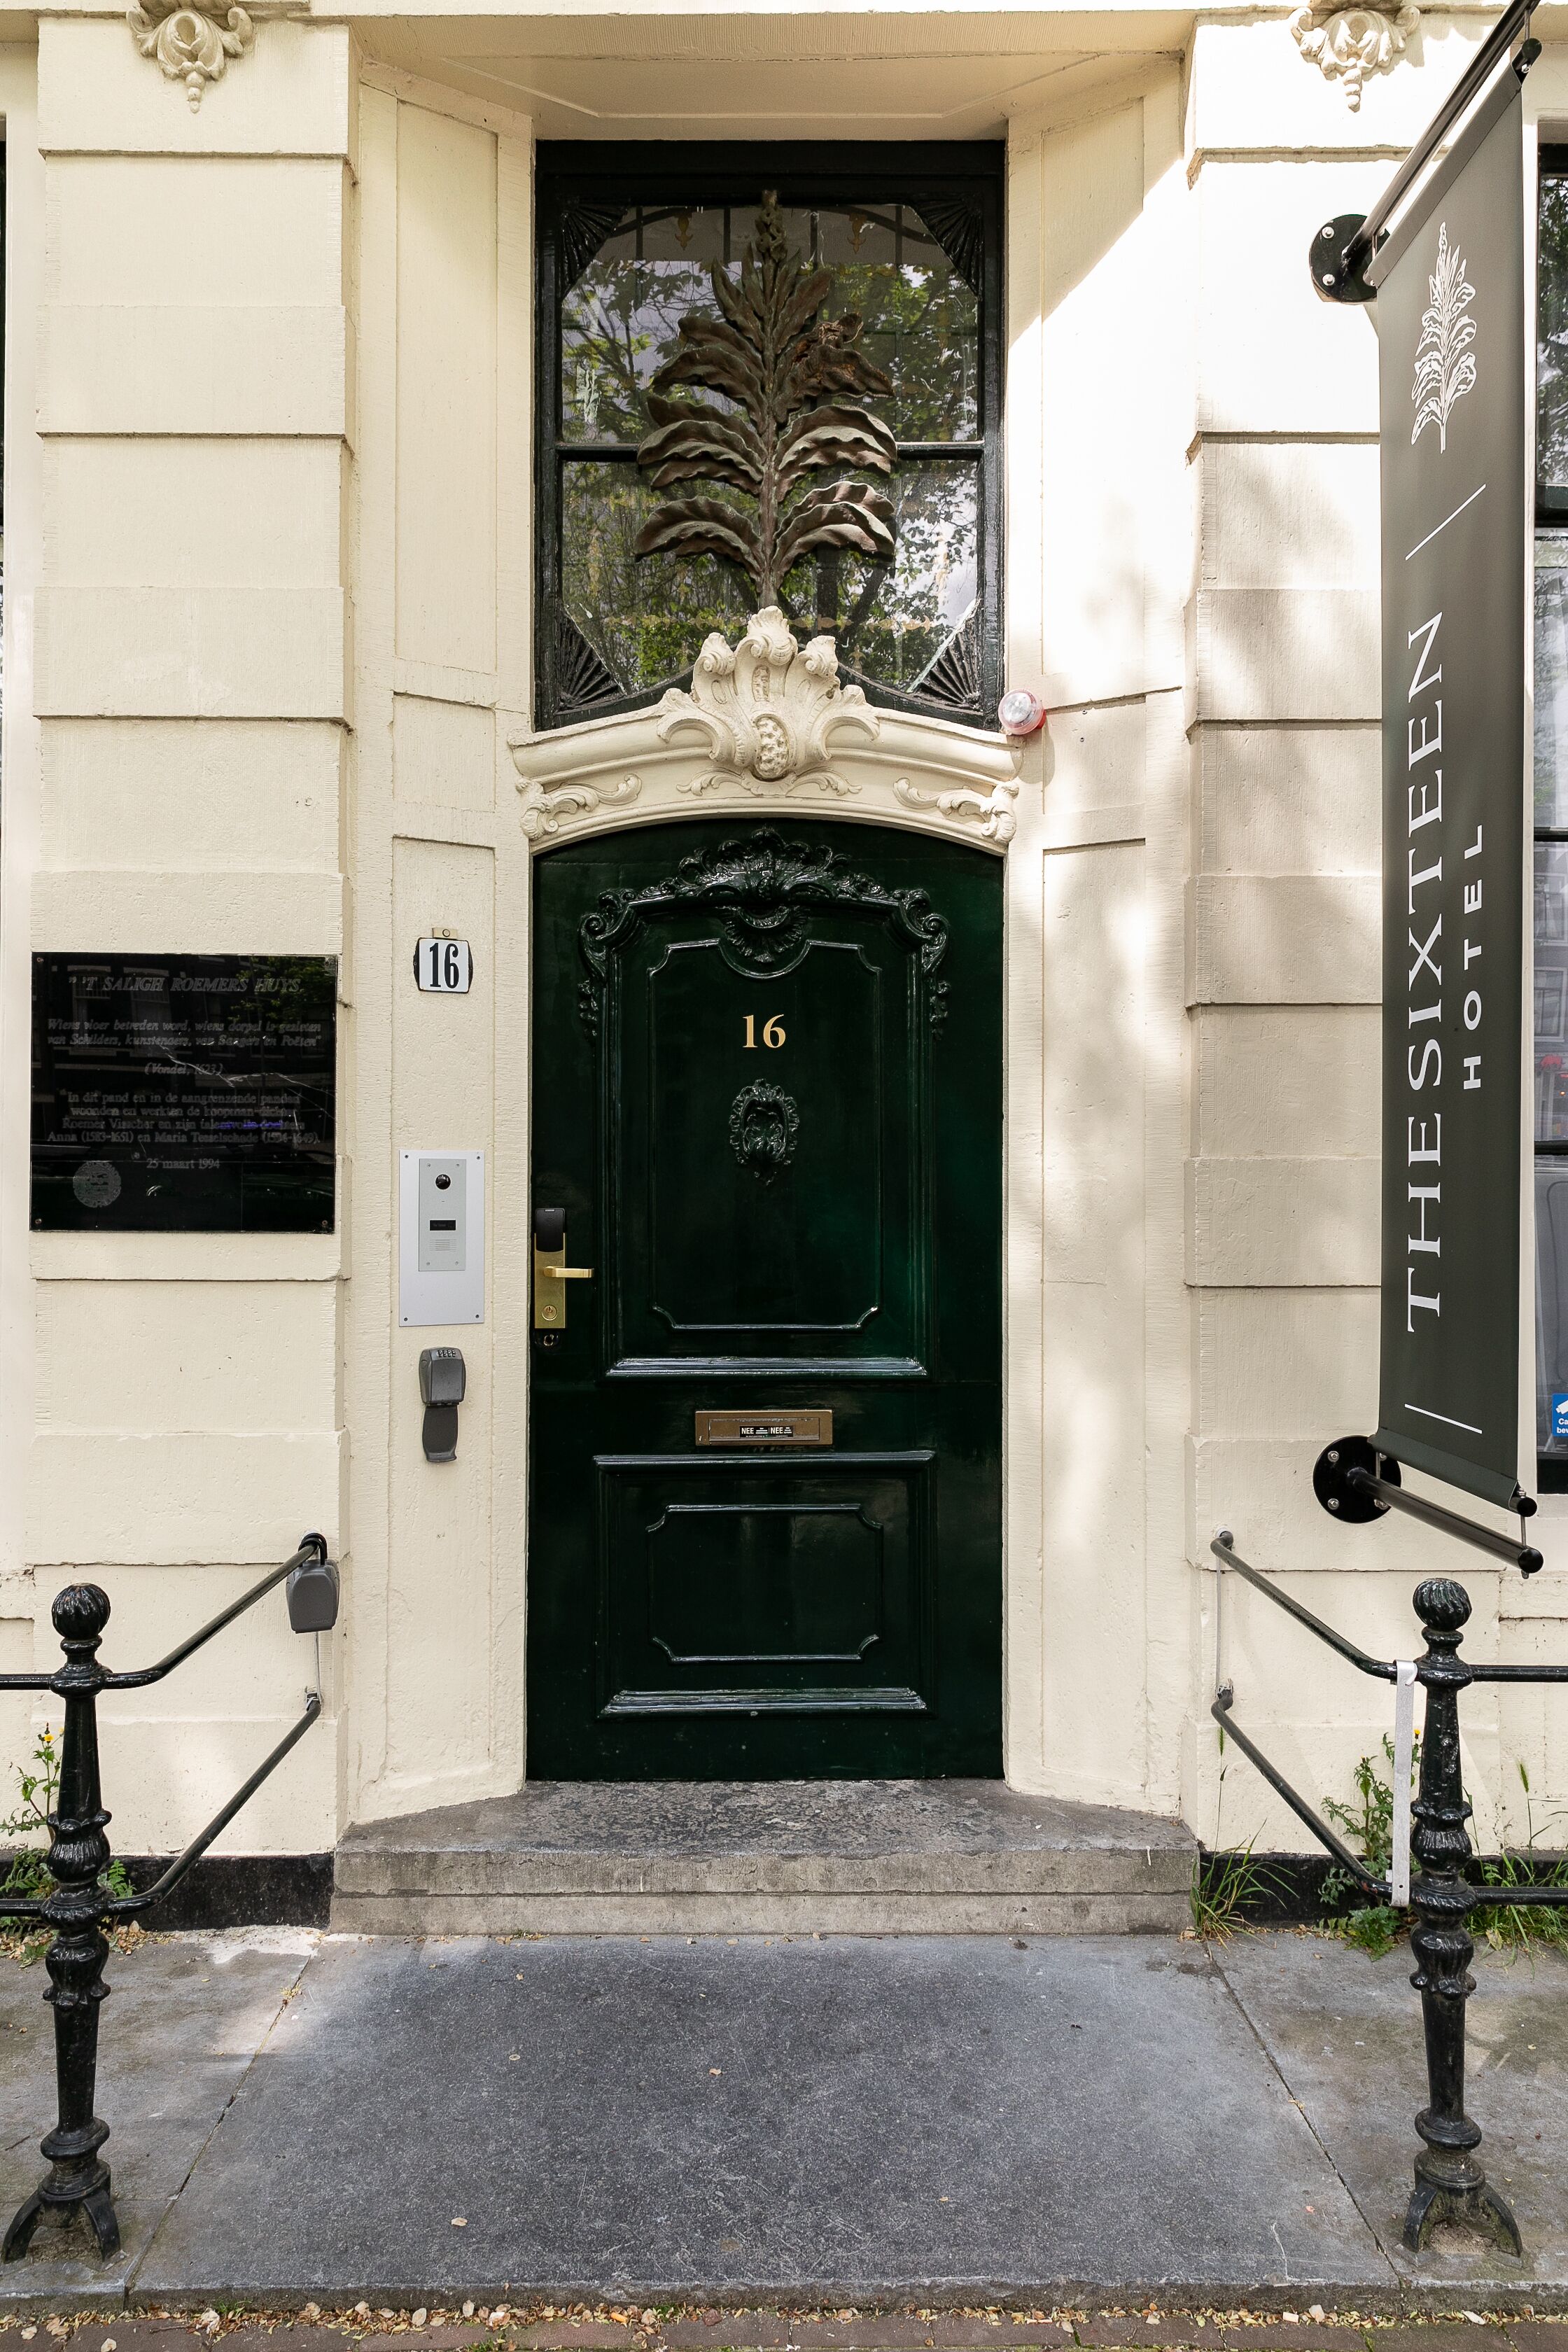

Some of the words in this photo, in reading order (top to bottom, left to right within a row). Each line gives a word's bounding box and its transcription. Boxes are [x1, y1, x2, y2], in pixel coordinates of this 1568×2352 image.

[1408, 612, 1442, 1091] SIXTEEN
[428, 941, 460, 988] 16
[1464, 825, 1483, 1090] HOTEL
[102, 976, 165, 992] SALIGH
[169, 977, 249, 993] ROEMERS
[253, 977, 301, 993] HUYS
[47, 1018, 80, 1031] Wiens
[113, 1018, 159, 1031] betreden
[742, 1014, 786, 1049] 16
[69, 1033, 122, 1046] Schilders,
[67, 1091, 79, 1102] In
[83, 1091, 99, 1102] dit
[102, 1092, 129, 1105] pand
[133, 1093, 146, 1102] en
[150, 1092, 162, 1102] in
[164, 1092, 179, 1102] de
[181, 1093, 257, 1105] aangrenzende
[70, 1105, 120, 1116] woonden
[122, 1107, 137, 1116] en
[140, 1106, 185, 1116] werkten
[187, 1105, 201, 1116] de
[62, 1117, 106, 1129] Roemer
[158, 1121, 172, 1129] en
[47, 1130, 78, 1142] Anna
[137, 1133, 151, 1142] en
[154, 1132, 188, 1142] Maria
[146, 1158, 160, 1168] 25
[162, 1159, 195, 1169] maart
[198, 1158, 220, 1169] 1994
[1408, 1113, 1441, 1333] THE
